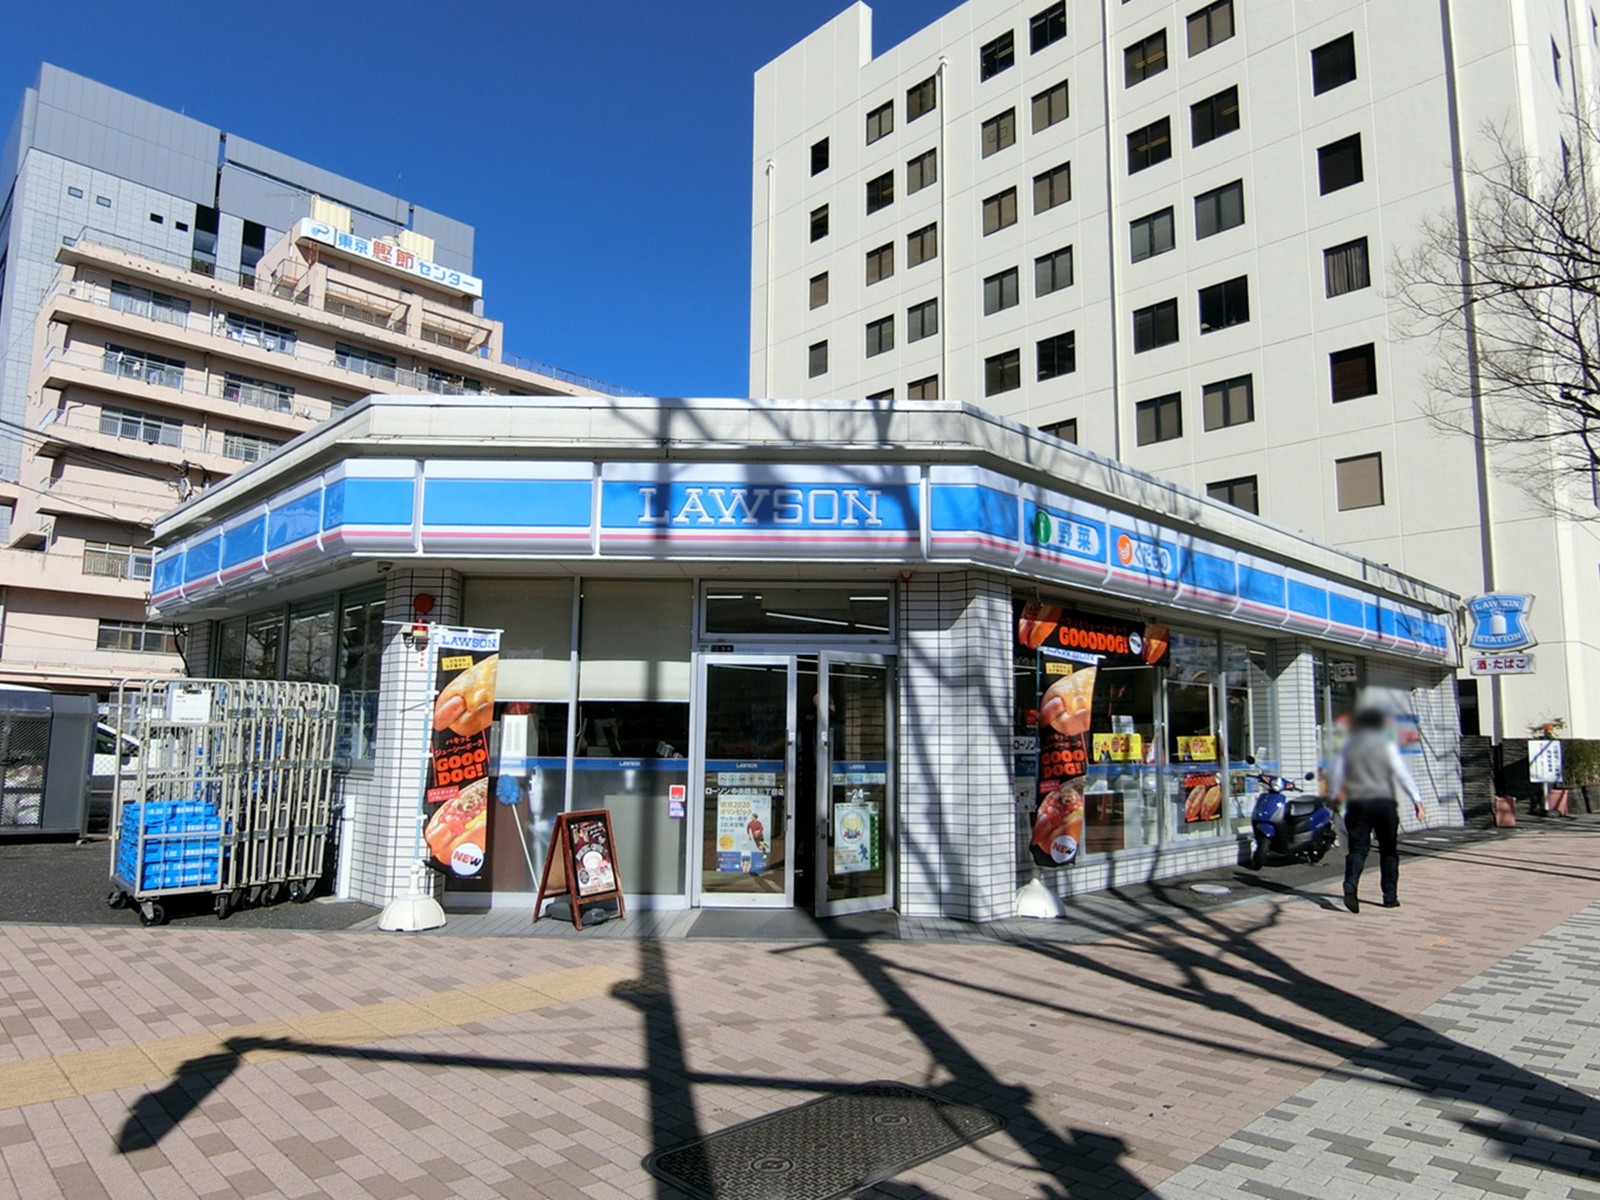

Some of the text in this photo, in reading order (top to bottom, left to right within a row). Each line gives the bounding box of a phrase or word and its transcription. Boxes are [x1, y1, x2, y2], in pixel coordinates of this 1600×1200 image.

[338, 232, 475, 288] 東京鰹節センター
[638, 487, 882, 525] LAWSON
[1058, 520, 1091, 551] 野菜
[1134, 542, 1169, 571] くだもの
[1474, 599, 1520, 610] LAWSON
[441, 635, 497, 648] LAWSON
[1058, 626, 1129, 654] GOOODOG!
[1476, 632, 1521, 643] STATION
[1476, 659, 1526, 670] 酒・たばこ
[436, 748, 486, 772] GOOO
[1041, 749, 1085, 765] GOOO
[438, 763, 484, 786] DOG!
[1043, 762, 1082, 778] DOG!
[1052, 842, 1074, 855] NEW
[453, 851, 482, 866] NEW
